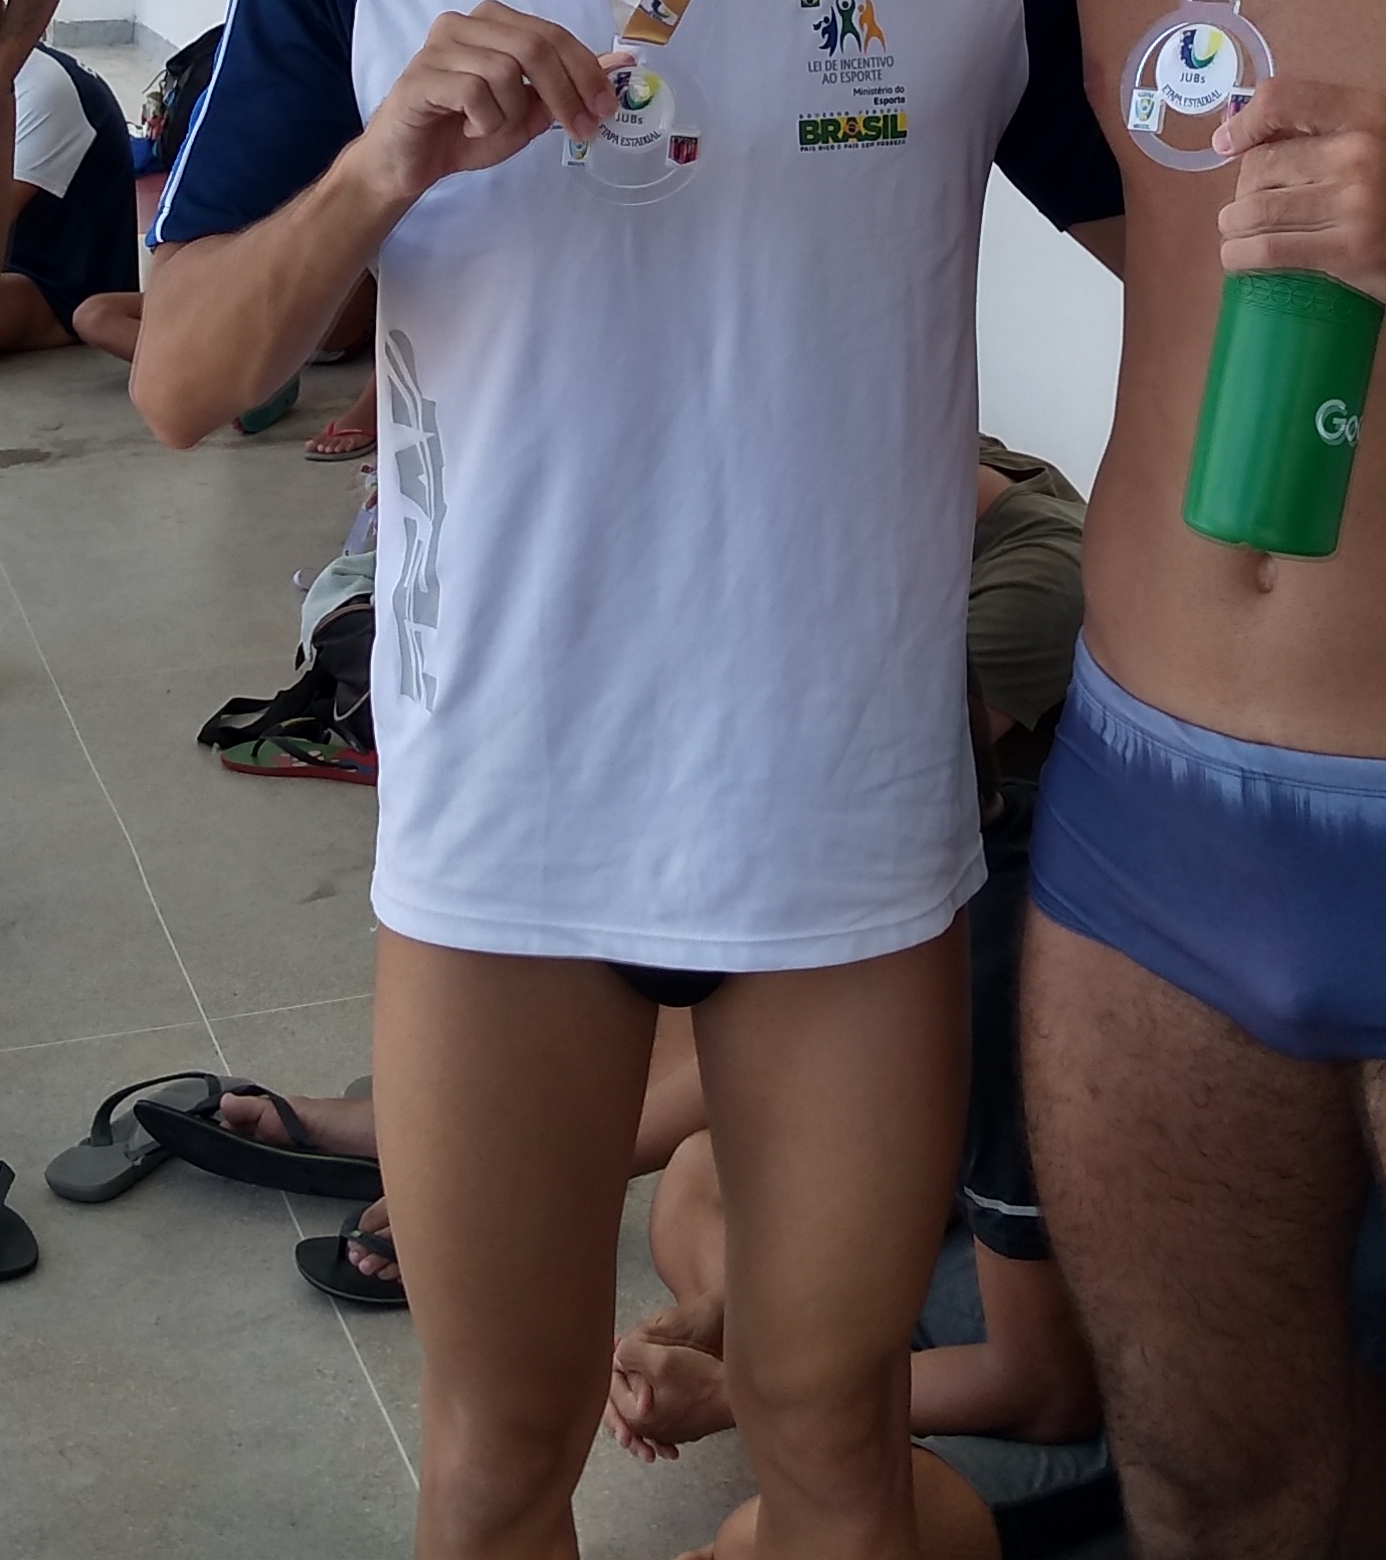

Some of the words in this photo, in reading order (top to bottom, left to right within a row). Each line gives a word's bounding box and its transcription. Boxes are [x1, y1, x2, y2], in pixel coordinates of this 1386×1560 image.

[807, 60, 822, 73] LEI
[825, 59, 838, 72] DE
[840, 55, 895, 70] INCENTIVO
[821, 72, 837, 85] AO
[840, 69, 883, 83] ESPORTE
[1179, 72, 1206, 85] JUBs
[853, 86, 893, 96] Ministério
[895, 85, 905, 94] do
[1162, 84, 1182, 106] ETAPA
[1183, 89, 1222, 108] ESTADUAL
[874, 96, 906, 106] Esporte
[615, 112, 644, 125] JUBs
[798, 113, 908, 146] BRASIL
[620, 130, 662, 148] ESTADUAL
